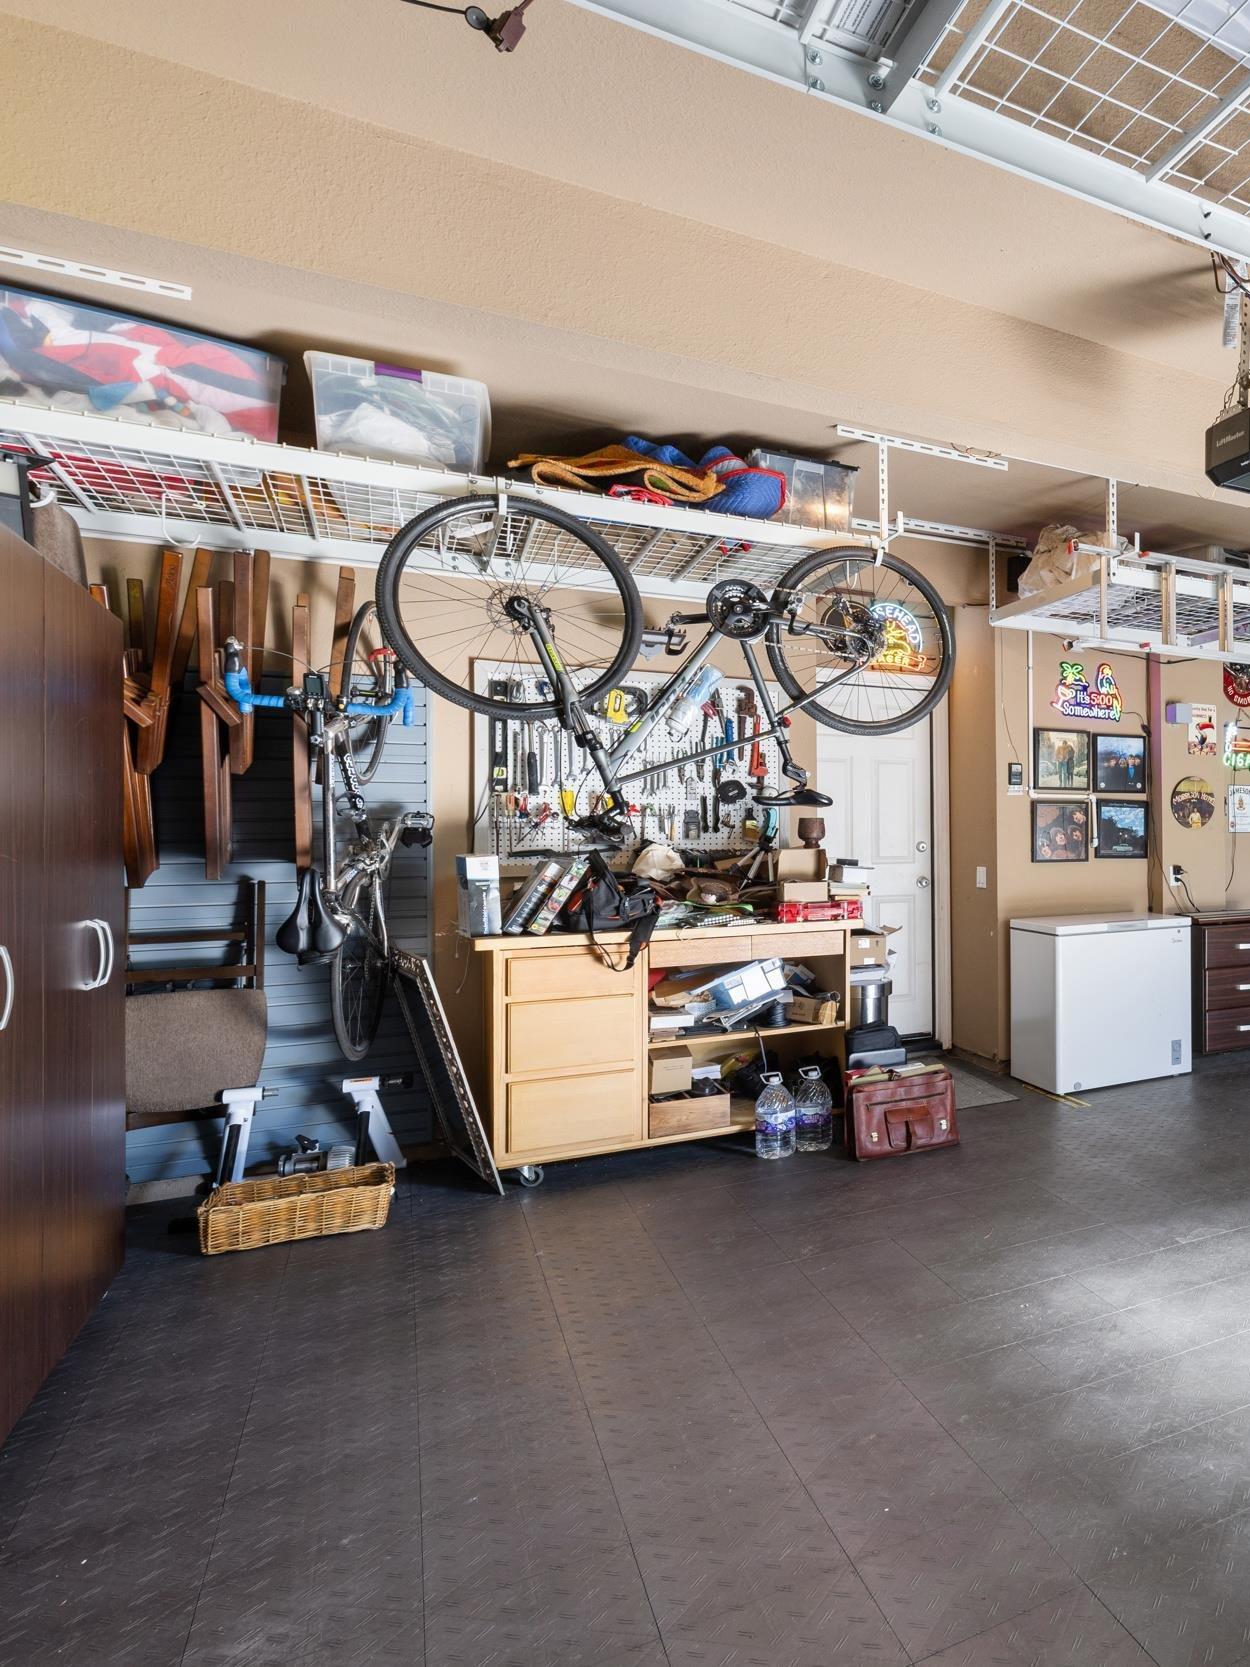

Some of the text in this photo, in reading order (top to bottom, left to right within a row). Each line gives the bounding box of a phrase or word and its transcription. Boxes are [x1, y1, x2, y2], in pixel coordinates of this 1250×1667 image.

[1227, 685, 1234, 696] NO
[1076, 691, 1113, 706] It's 5:00
[1063, 701, 1116, 719] Somewhere
[1172, 791, 1200, 805] MORRISON
